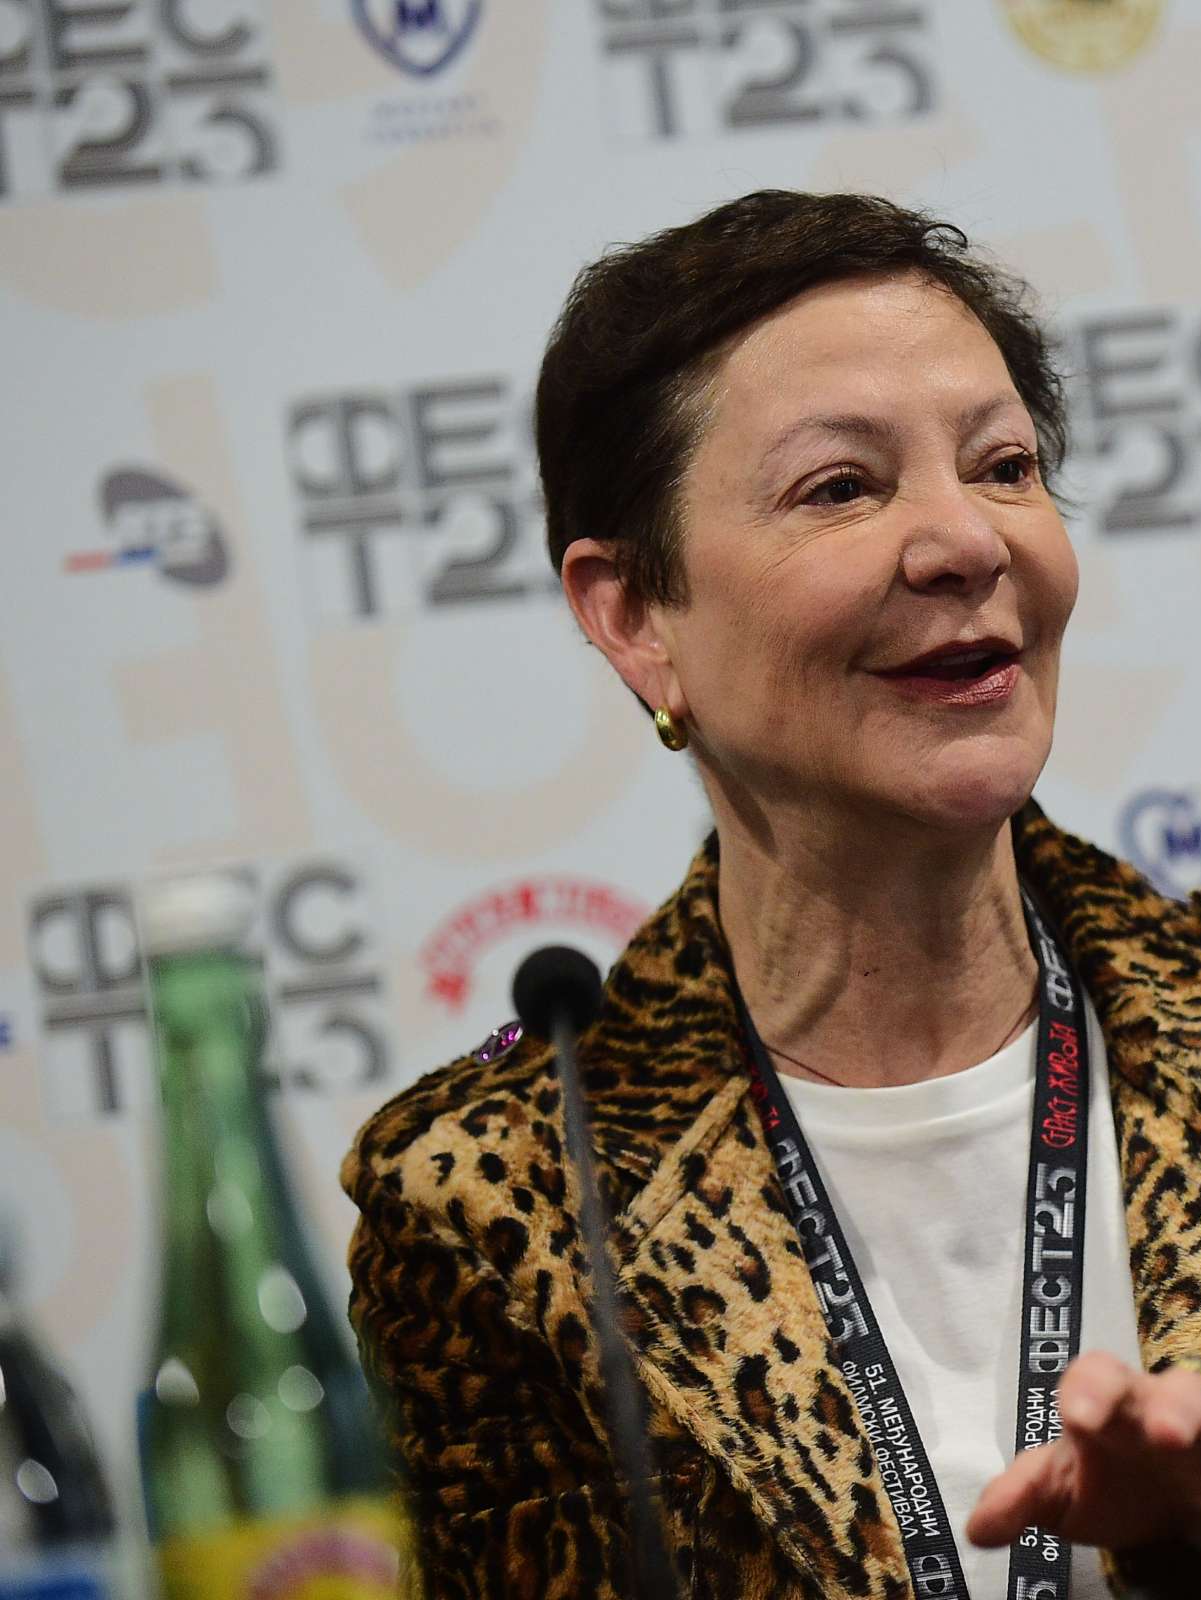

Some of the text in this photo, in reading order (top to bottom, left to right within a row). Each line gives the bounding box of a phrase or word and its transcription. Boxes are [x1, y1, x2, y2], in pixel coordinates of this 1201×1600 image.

[0, 0, 256, 70] ЕС
[287, 376, 530, 500] ФЕ
[301, 498, 562, 617] Т2
[28, 865, 364, 995] ФС
[43, 974, 386, 1114] Т3
[864, 1361, 941, 1538] 51. МЕЂУНАРОДНИ
[876, 1446, 918, 1539] ФЕСТИВАЛ
